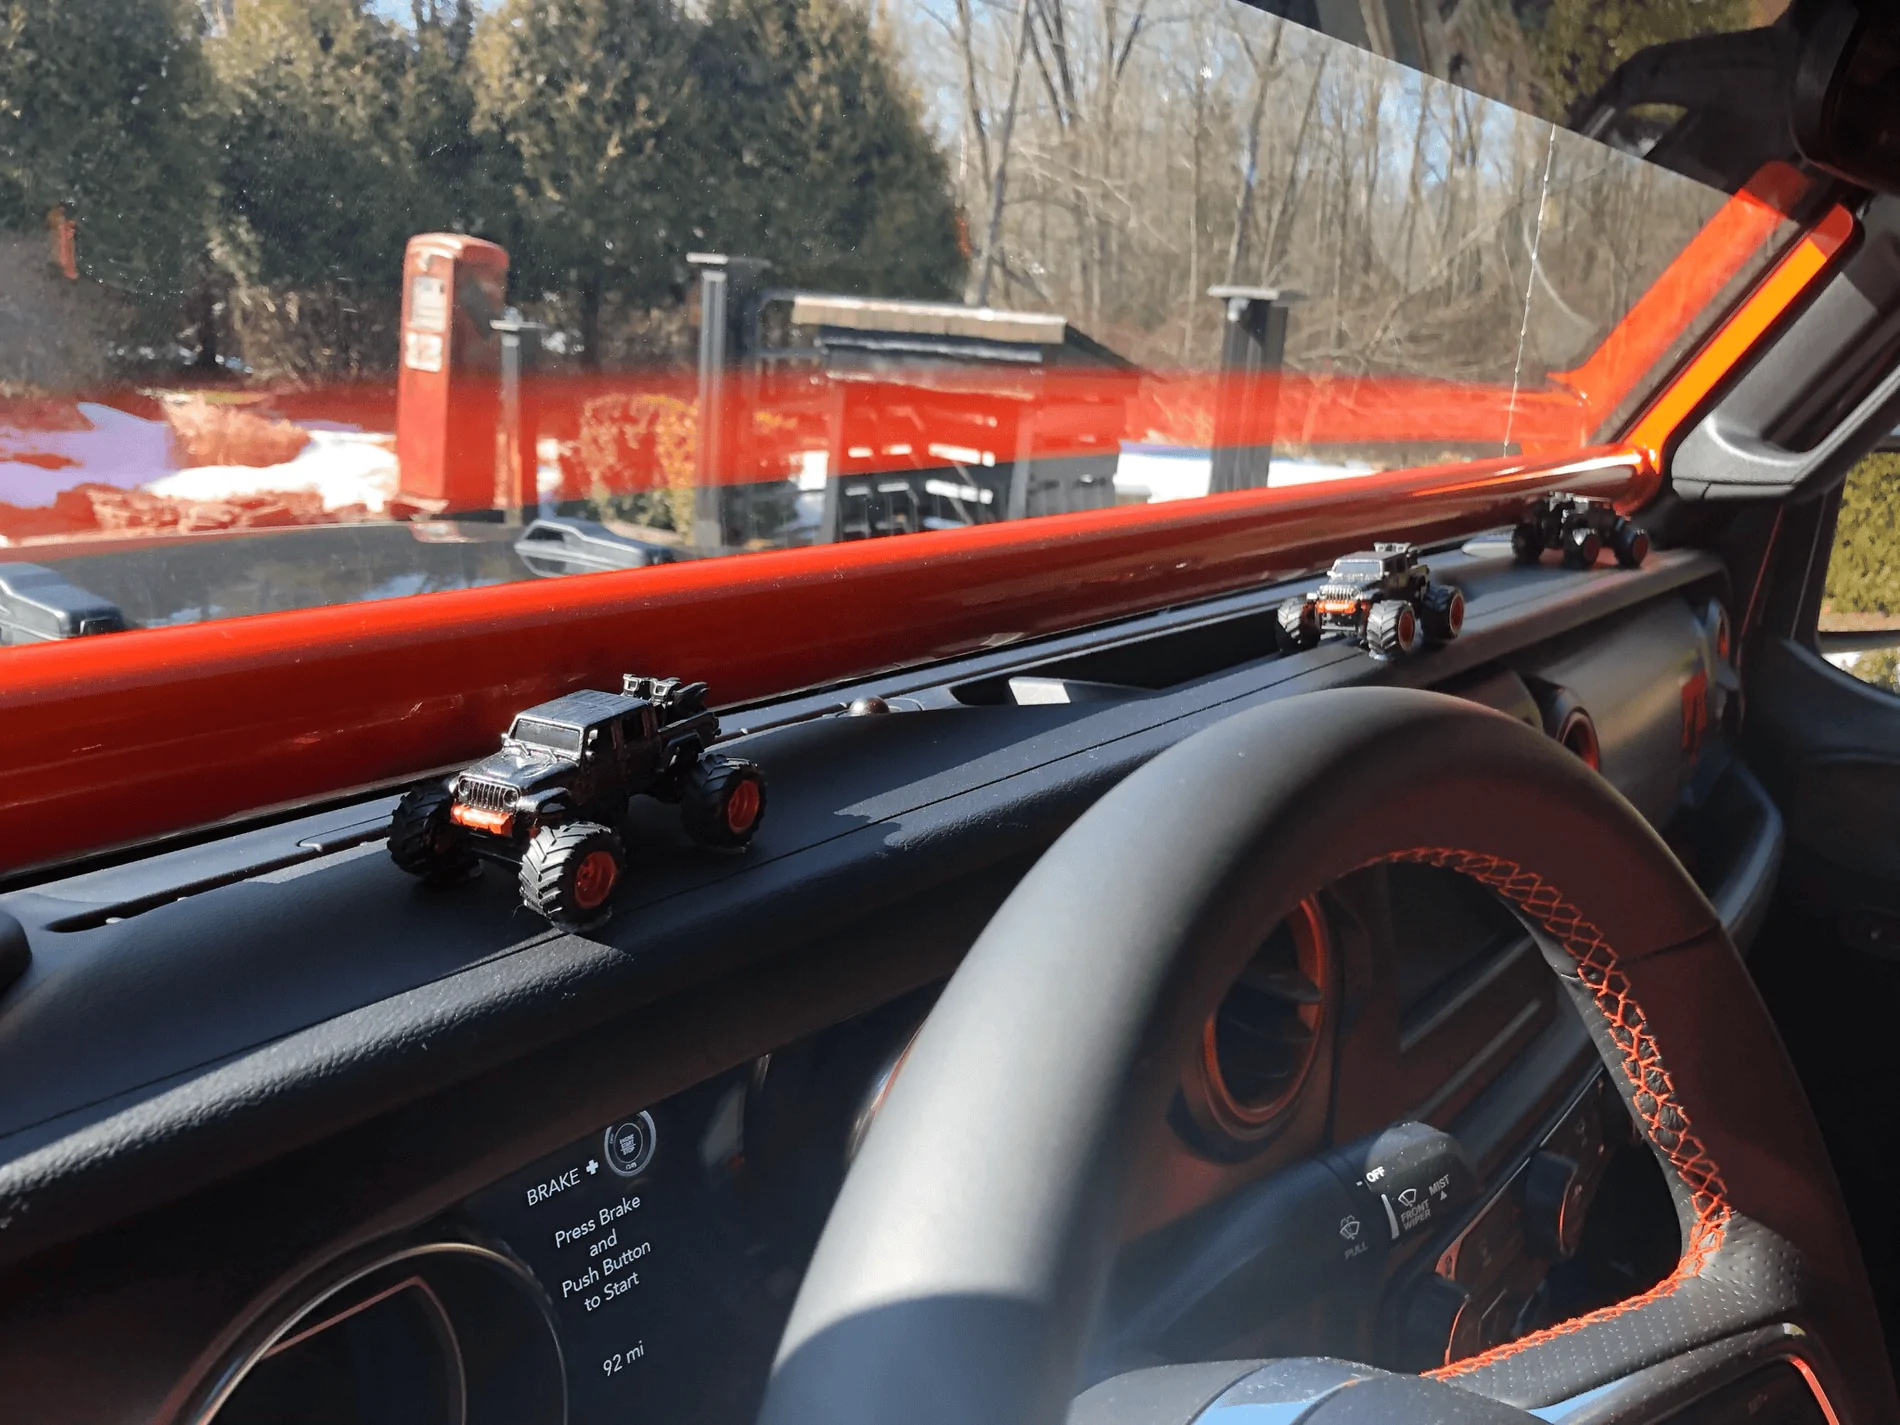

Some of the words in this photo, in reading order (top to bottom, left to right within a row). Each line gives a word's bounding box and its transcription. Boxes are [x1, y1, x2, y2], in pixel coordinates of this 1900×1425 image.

[526, 1168, 580, 1206] BRAKE
[1366, 1166, 1385, 1183] OFF
[1429, 1174, 1450, 1196] MIST
[555, 1220, 596, 1248] Press
[599, 1196, 641, 1226] Brake
[1400, 1199, 1430, 1222] FRONT
[1404, 1209, 1431, 1231] WIPER
[589, 1228, 618, 1257] and
[1344, 1242, 1368, 1260] PULL
[562, 1266, 600, 1298] Push
[603, 1241, 651, 1276] Button
[584, 1296, 600, 1312] to
[604, 1271, 640, 1301] Start
[603, 1354, 623, 1377] 92
[627, 1341, 645, 1364] mi
